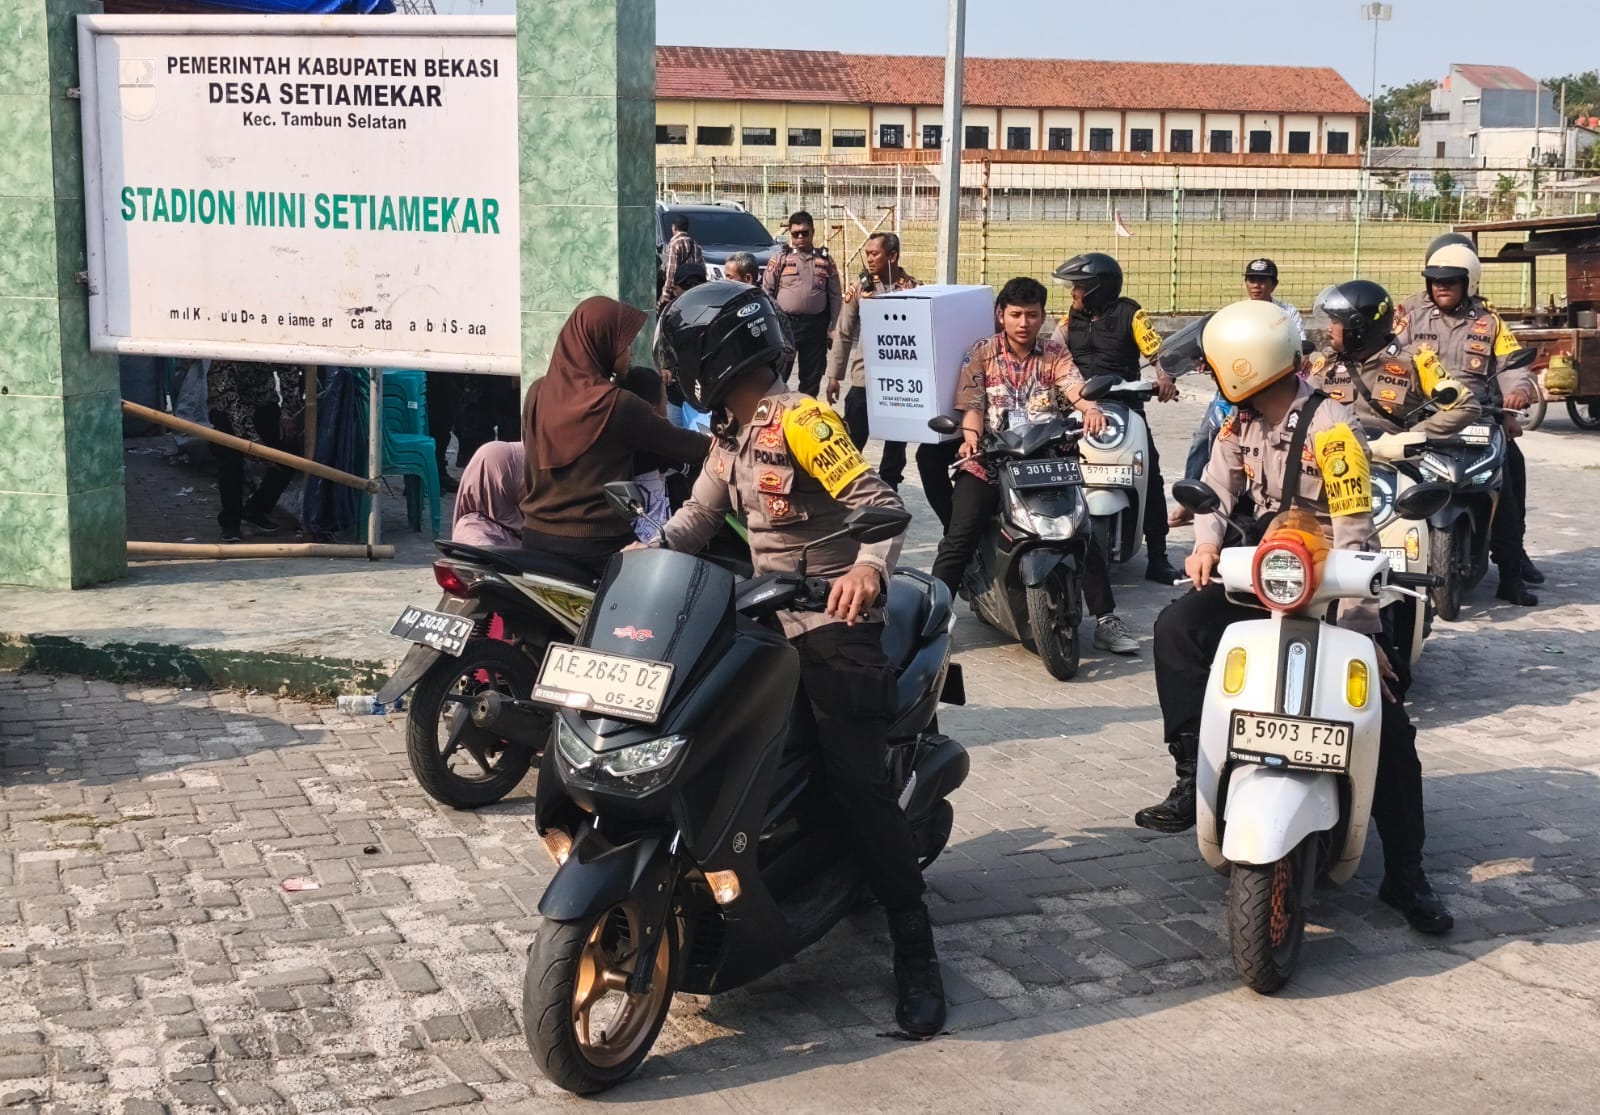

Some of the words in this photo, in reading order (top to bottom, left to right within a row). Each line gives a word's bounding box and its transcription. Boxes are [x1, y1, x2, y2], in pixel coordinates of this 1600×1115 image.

[167, 56, 291, 76] PEMERINTAH
[299, 57, 417, 78] KABUPATEN
[424, 58, 499, 79] BEKASI
[208, 82, 272, 105] DESA
[280, 83, 443, 108] SETIAMEKAR
[243, 112, 277, 127] Kec.
[281, 112, 342, 128] Tambun
[347, 113, 407, 130] Selatan
[121, 186, 236, 225] STADION
[245, 190, 306, 228] MINI
[313, 193, 501, 234] SETIAMEKAR
[877, 334, 917, 347] KOTAK
[1467, 334, 1491, 342] POLRI
[878, 349, 918, 360] SUARA
[877, 377, 904, 393] TPS
[907, 379, 923, 393] 30
[1377, 375, 1408, 387] POLRI
[754, 449, 789, 466] POLRI
[814, 444, 841, 473] PAM
[1013, 467, 1020, 476] B
[1026, 464, 1052, 475] 3016
[1343, 478, 1363, 496] TPS
[420, 614, 449, 632] 5038
[553, 654, 580, 675] AE
[583, 659, 631, 683] 2645
[636, 667, 662, 691] DZ
[1236, 718, 1246, 736] B
[1255, 720, 1300, 742] 5993
